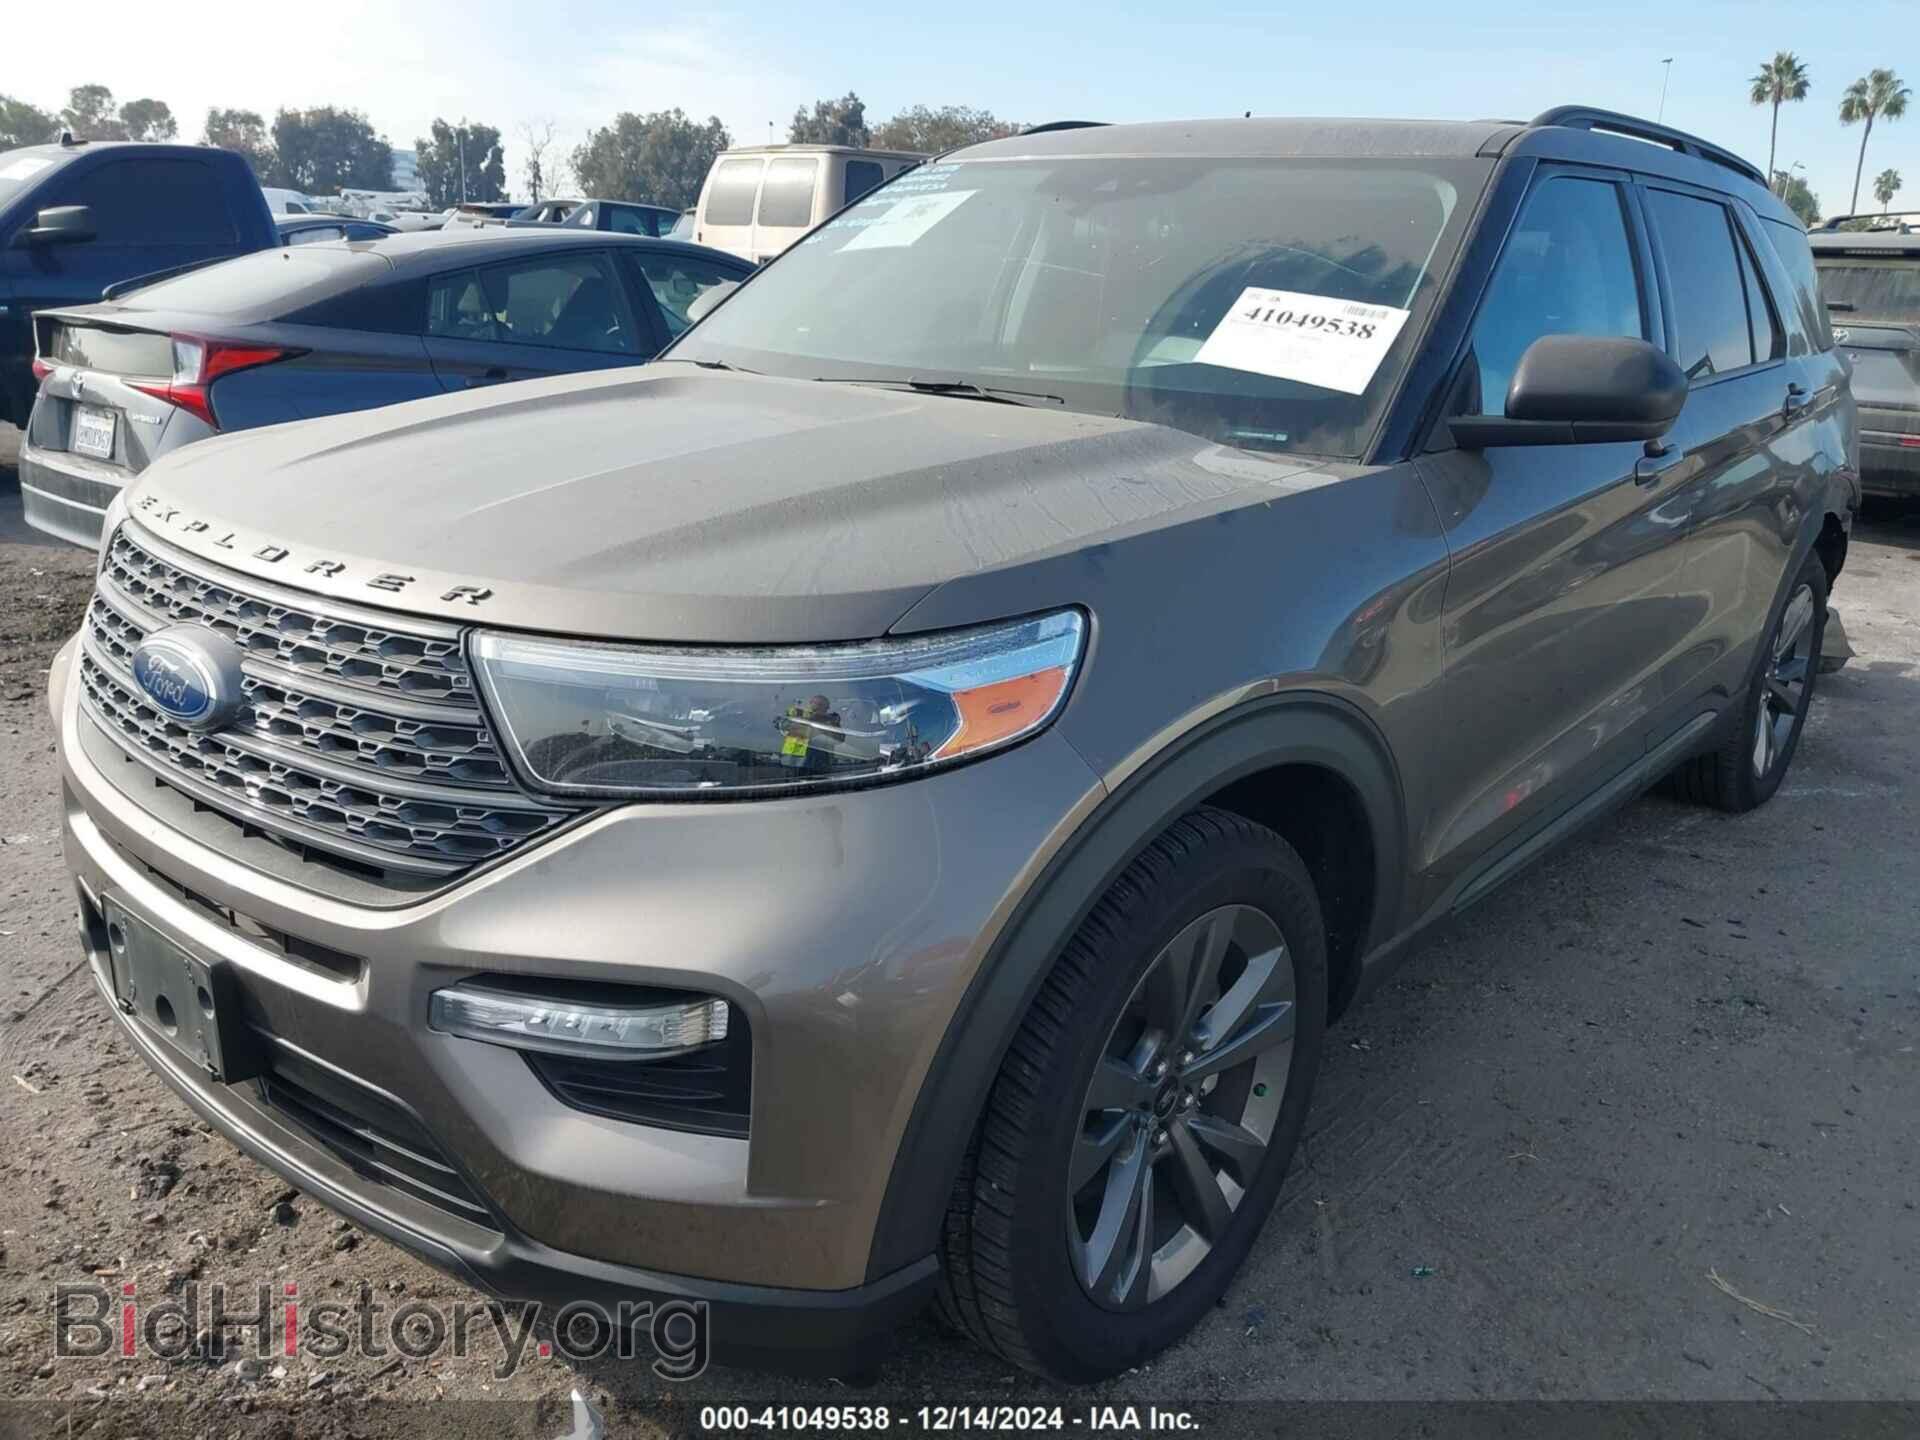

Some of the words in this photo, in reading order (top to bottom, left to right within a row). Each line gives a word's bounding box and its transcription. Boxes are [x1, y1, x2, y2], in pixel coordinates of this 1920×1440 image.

[1245, 307, 1376, 339] 41049538
[139, 495, 495, 606] EXPLORER
[143, 654, 190, 707] Ford
